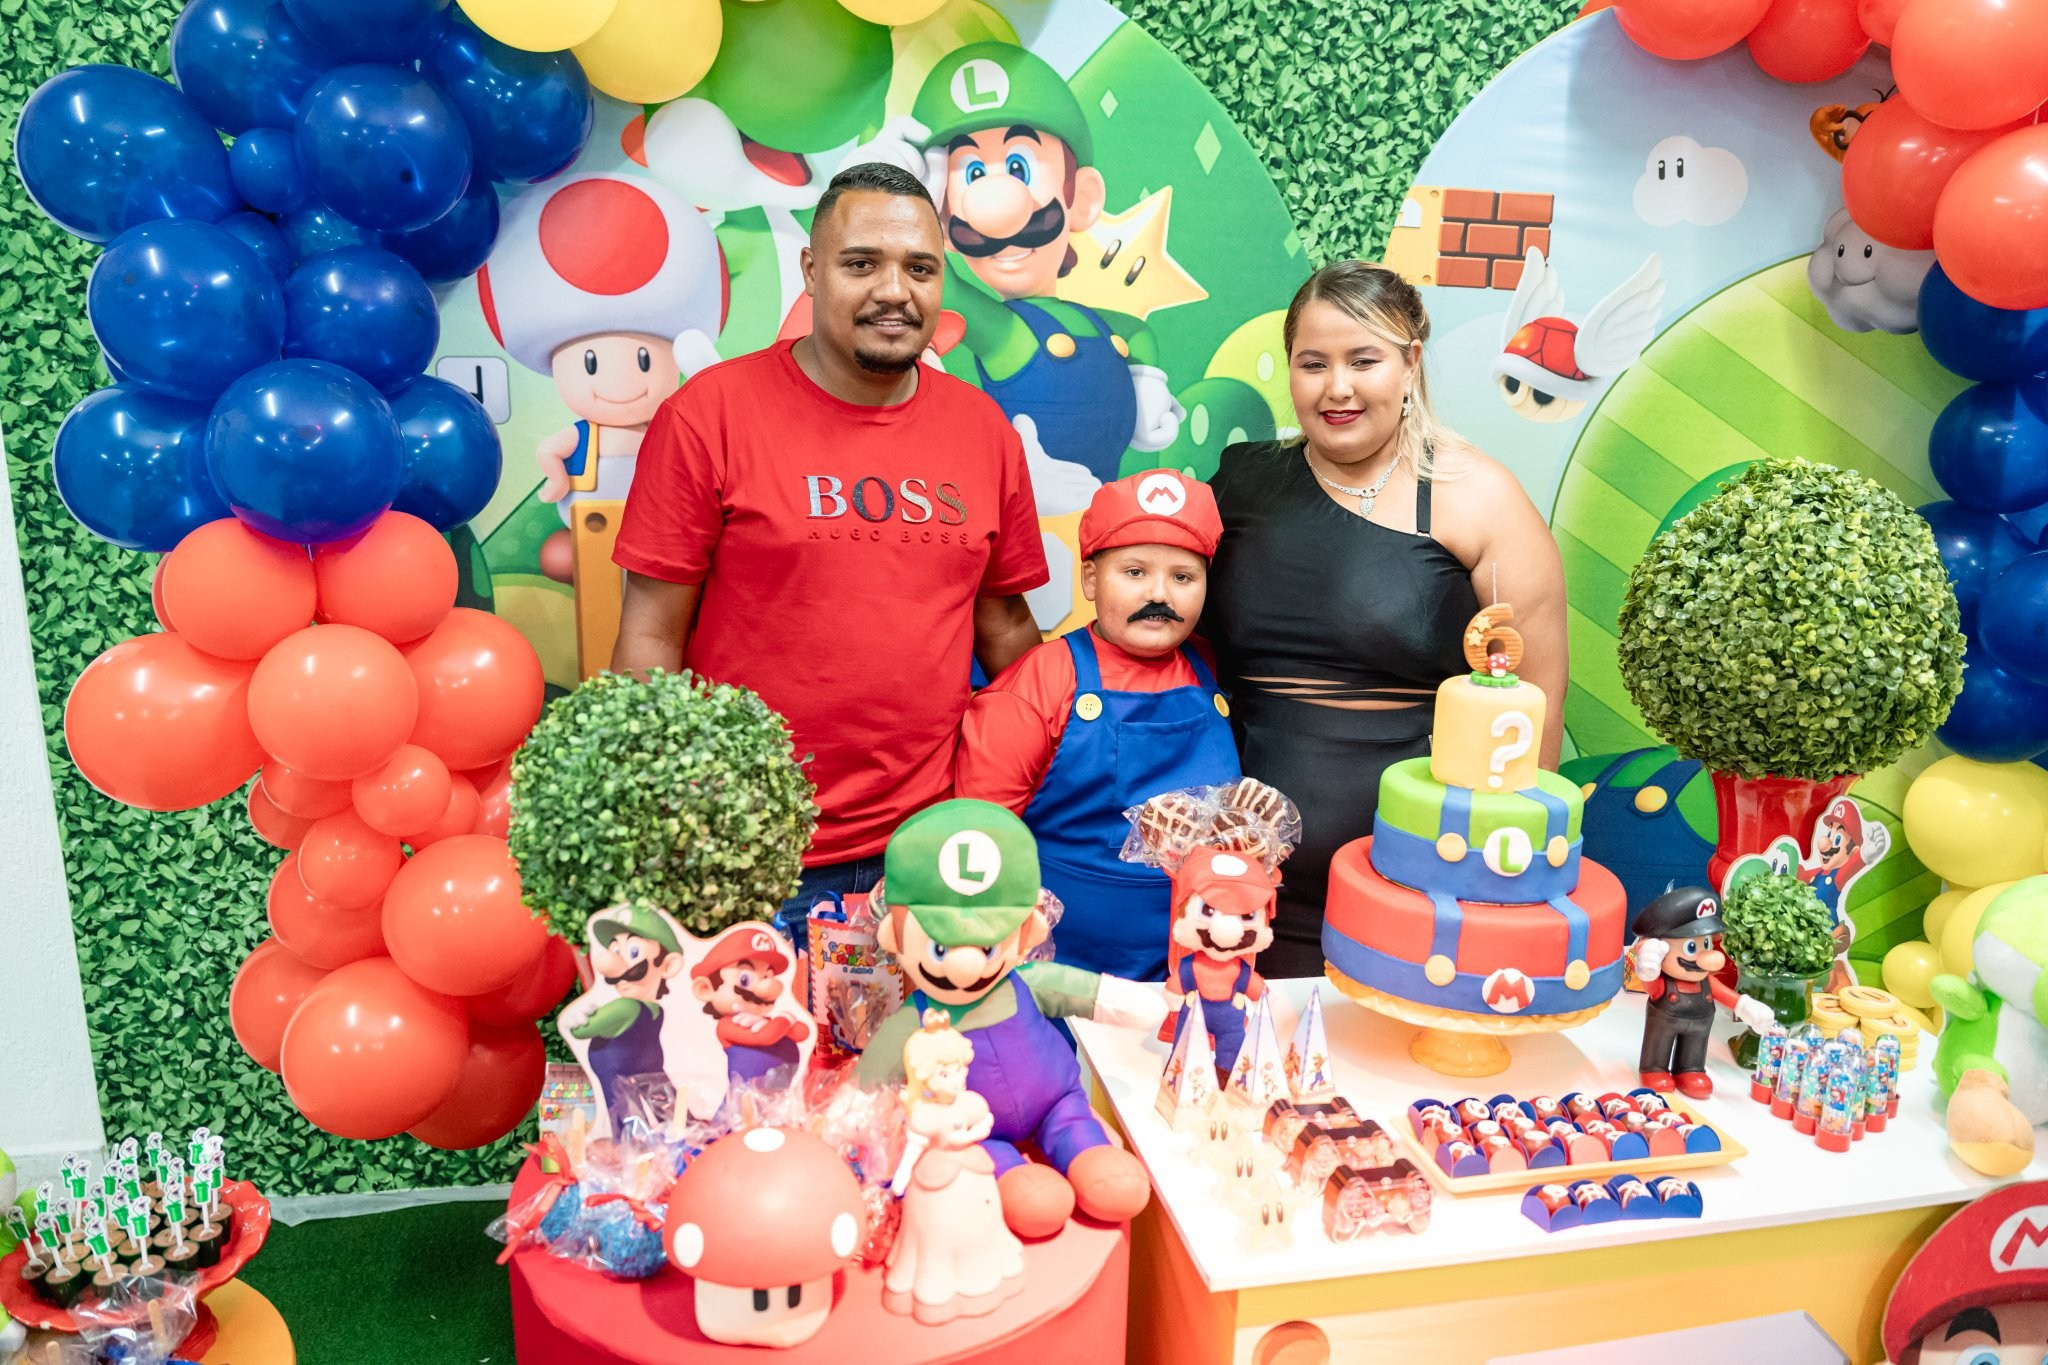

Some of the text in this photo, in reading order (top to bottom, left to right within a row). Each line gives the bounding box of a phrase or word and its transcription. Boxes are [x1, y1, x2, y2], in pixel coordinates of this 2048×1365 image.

[963, 66, 998, 105] L
[803, 475, 968, 525] BOSS
[1145, 486, 1178, 503] M
[808, 526, 969, 546] HUGO BOSS
[1463, 602, 1524, 676] 6
[1834, 806, 1844, 817] M
[957, 843, 986, 883] L
[1500, 832, 1523, 873] L
[1698, 901, 1715, 917] M
[1486, 972, 1530, 1008] M
